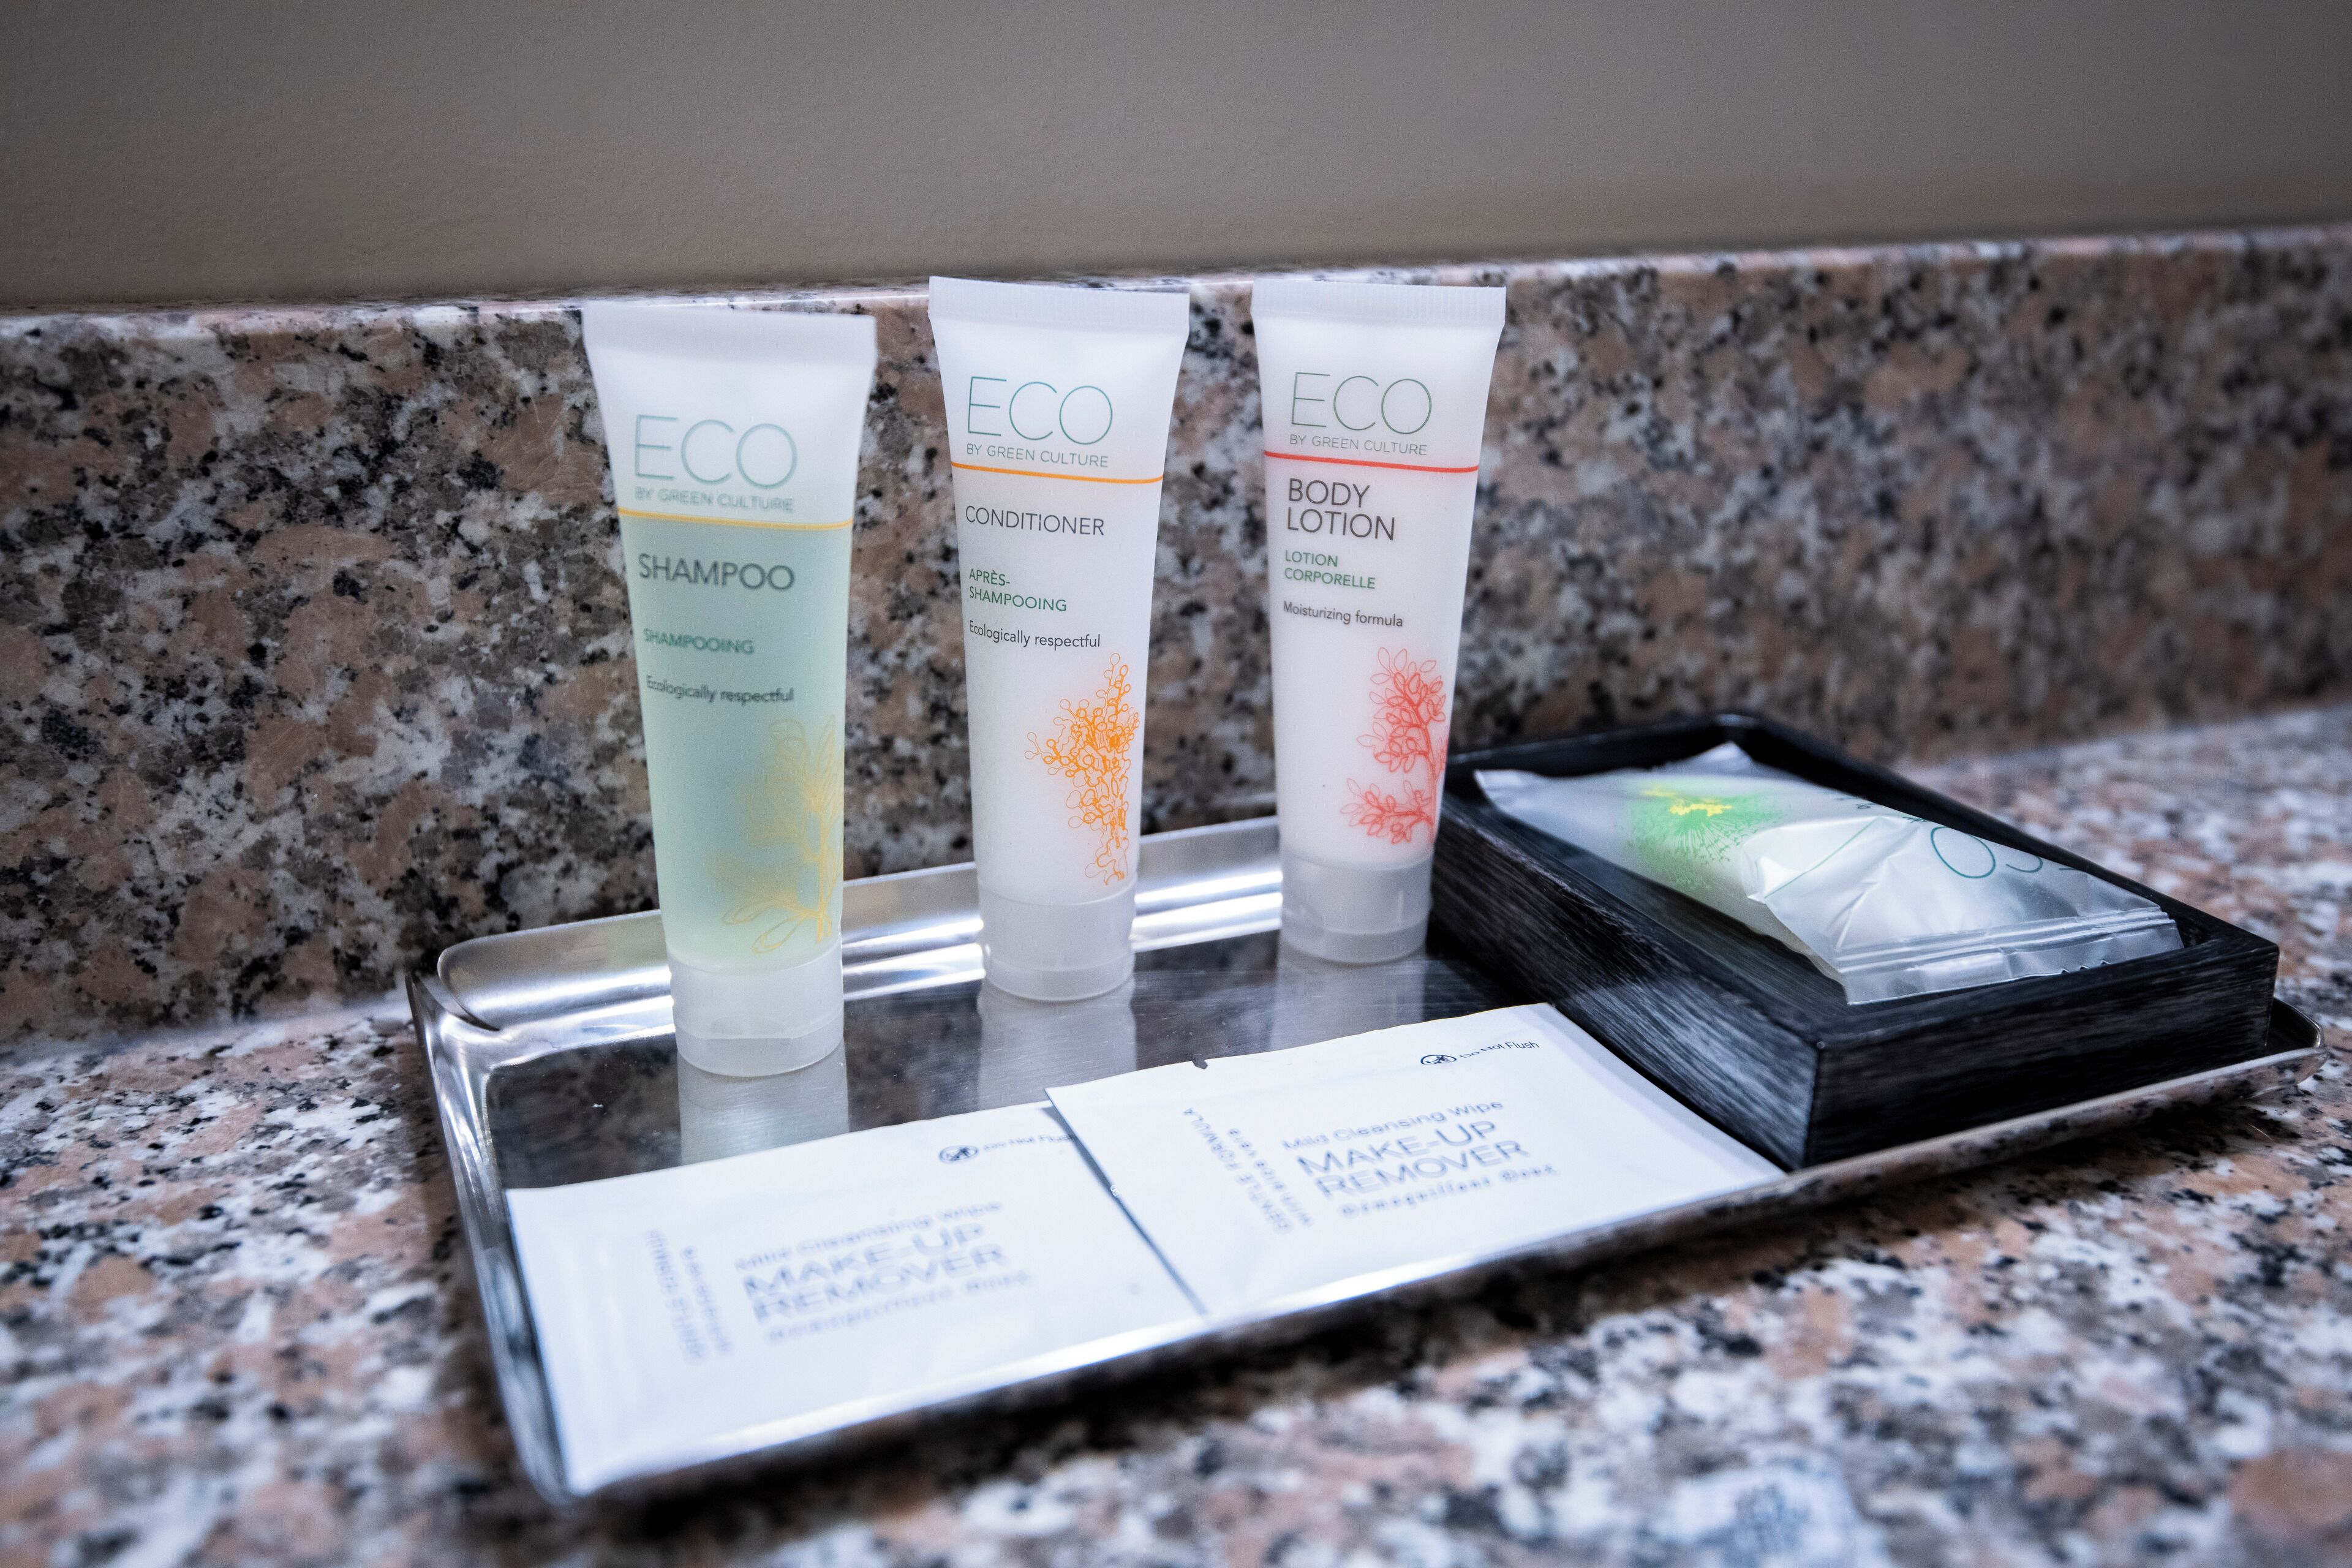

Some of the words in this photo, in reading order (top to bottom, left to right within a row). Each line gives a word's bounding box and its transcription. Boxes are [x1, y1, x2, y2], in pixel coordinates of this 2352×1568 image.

[970, 375, 1113, 445] ECO
[1291, 372, 1432, 435] ECO
[634, 413, 798, 489] ECO
[967, 443, 982, 455] BY
[987, 445, 1035, 461] GREEN
[1040, 450, 1109, 468] CULTURE
[1289, 434, 1307, 445] BY
[1312, 435, 1359, 450] GREEN
[1363, 440, 1428, 456] CULTURE
[635, 486, 654, 500] BY
[658, 488, 712, 505] GREEN
[717, 492, 794, 512] CULTURE
[1288, 478, 1370, 508] BODY
[965, 505, 1105, 535] CONDITIONER
[1287, 507, 1396, 541] LOTION
[638, 553, 795, 590] SHAMPOO
[1285, 550, 1338, 567] LOTION
[969, 568, 1011, 587] APRÈS-
[1284, 568, 1376, 589] CORPORELLE
[969, 586, 1068, 612] SHAMPOOING
[1283, 600, 1351, 625] Moisturizing
[1355, 610, 1403, 628] formula
[643, 628, 755, 654] SHAMPOOING
[969, 619, 1030, 647] Ecologically
[1035, 633, 1101, 650] respectful
[646, 676, 715, 703] Ecologically
[719, 687, 794, 706] respectful
[1504, 1041, 1541, 1050] Flush
[1295, 1120, 1497, 1177] MAKE-UP
[1314, 1139, 1531, 1199] REMOVER
[742, 1223, 985, 1300] MAKE-UP
